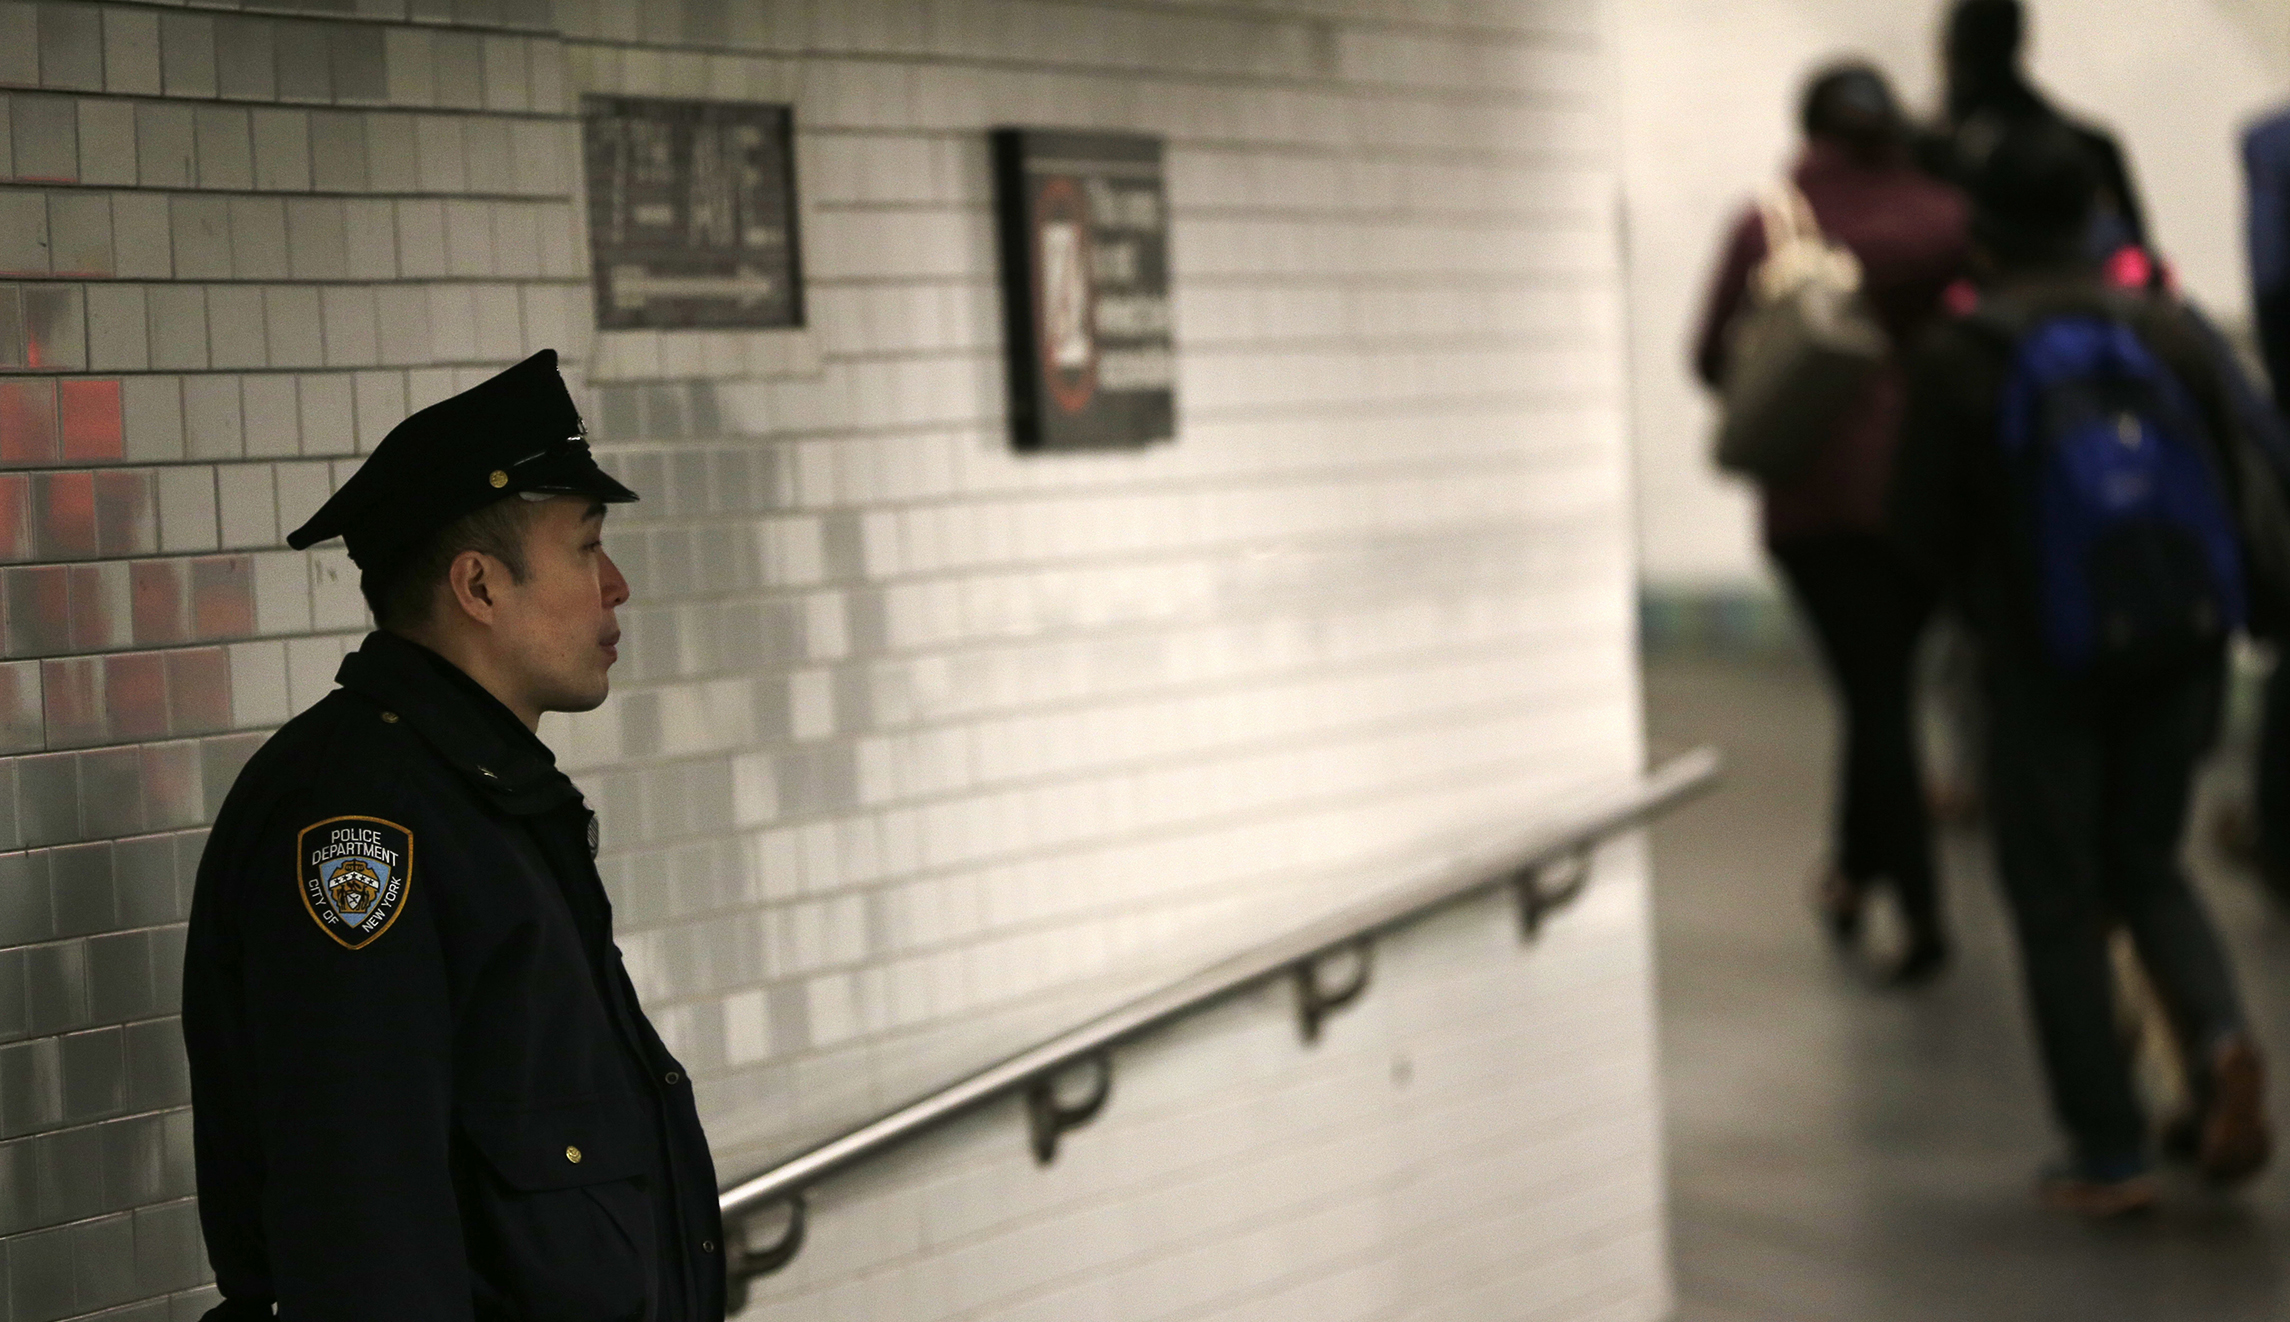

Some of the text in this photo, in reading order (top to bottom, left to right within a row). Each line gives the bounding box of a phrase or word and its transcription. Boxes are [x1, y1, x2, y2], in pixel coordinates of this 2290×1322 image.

[331, 828, 382, 845] POLICE
[312, 842, 399, 867] DEPARTMENT
[308, 876, 402, 933] CITY OF NEW YORK
